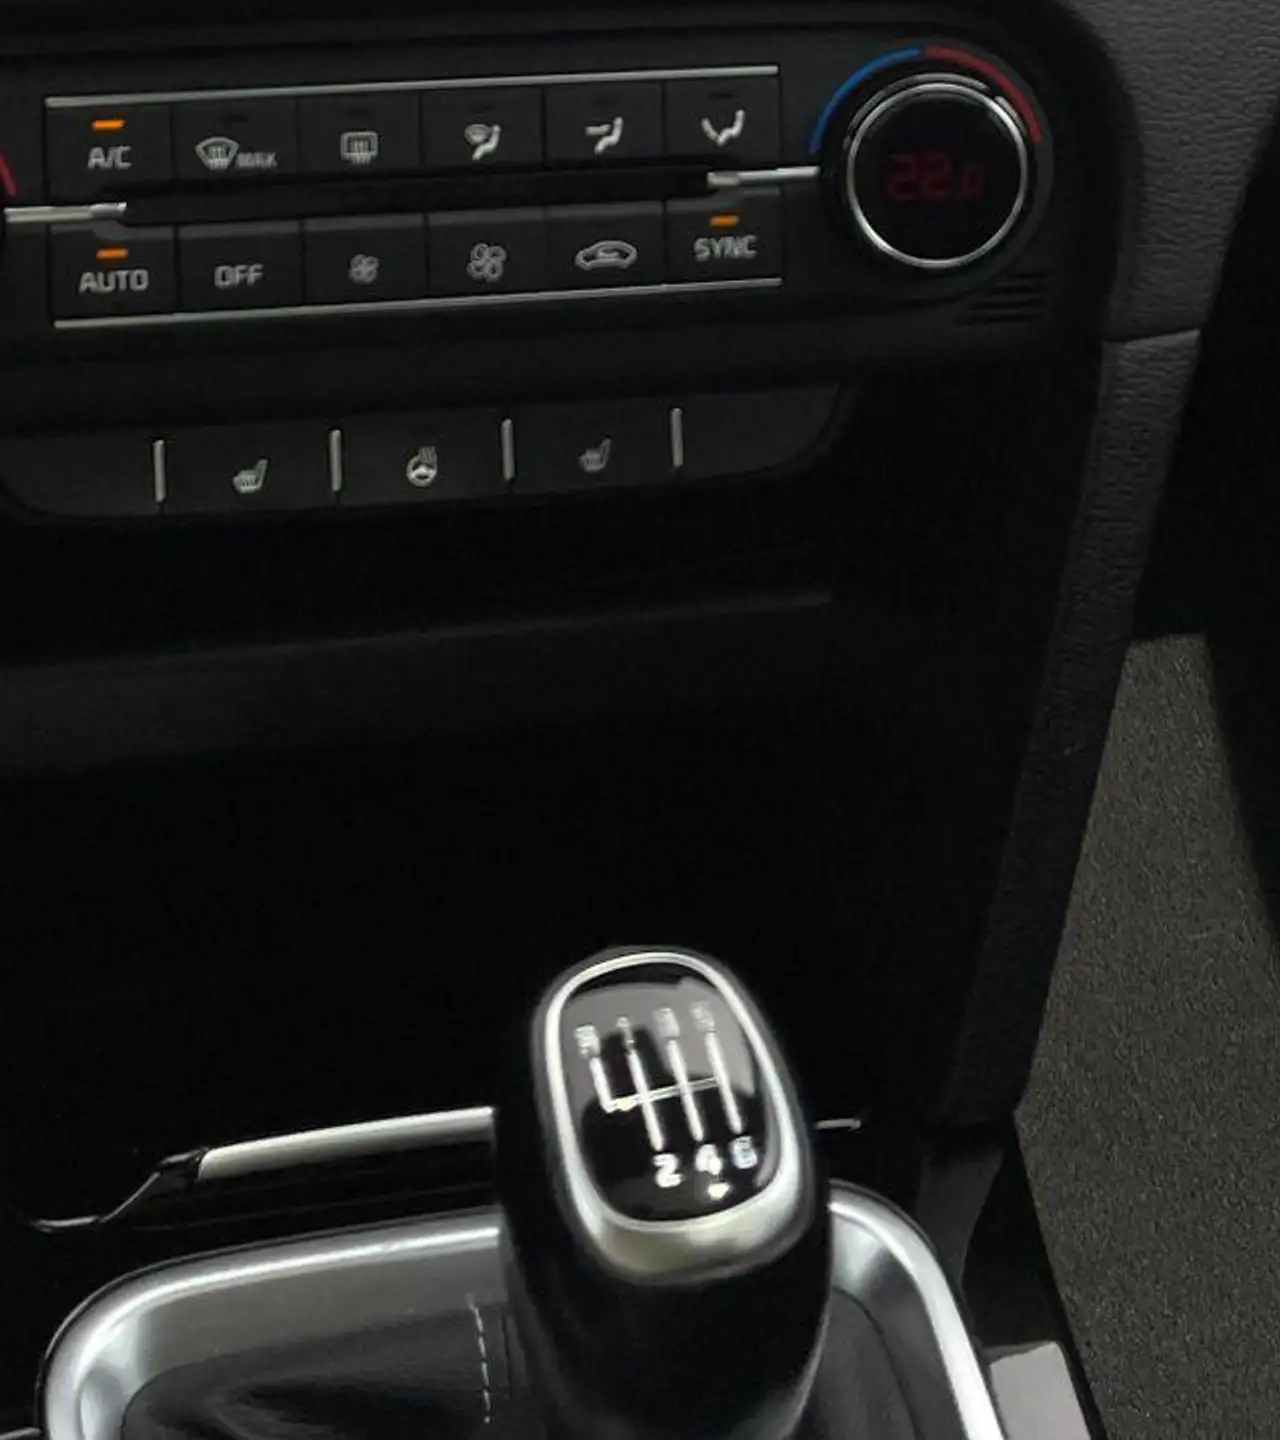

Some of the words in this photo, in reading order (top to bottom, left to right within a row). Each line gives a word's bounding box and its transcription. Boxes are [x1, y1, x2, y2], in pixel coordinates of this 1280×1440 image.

[87, 146, 132, 169] A/C
[693, 234, 758, 262] SYNC
[78, 269, 150, 295] AUTO
[213, 263, 265, 290] OFF
[653, 1153, 685, 1188] 2
[695, 1143, 723, 1177] 4
